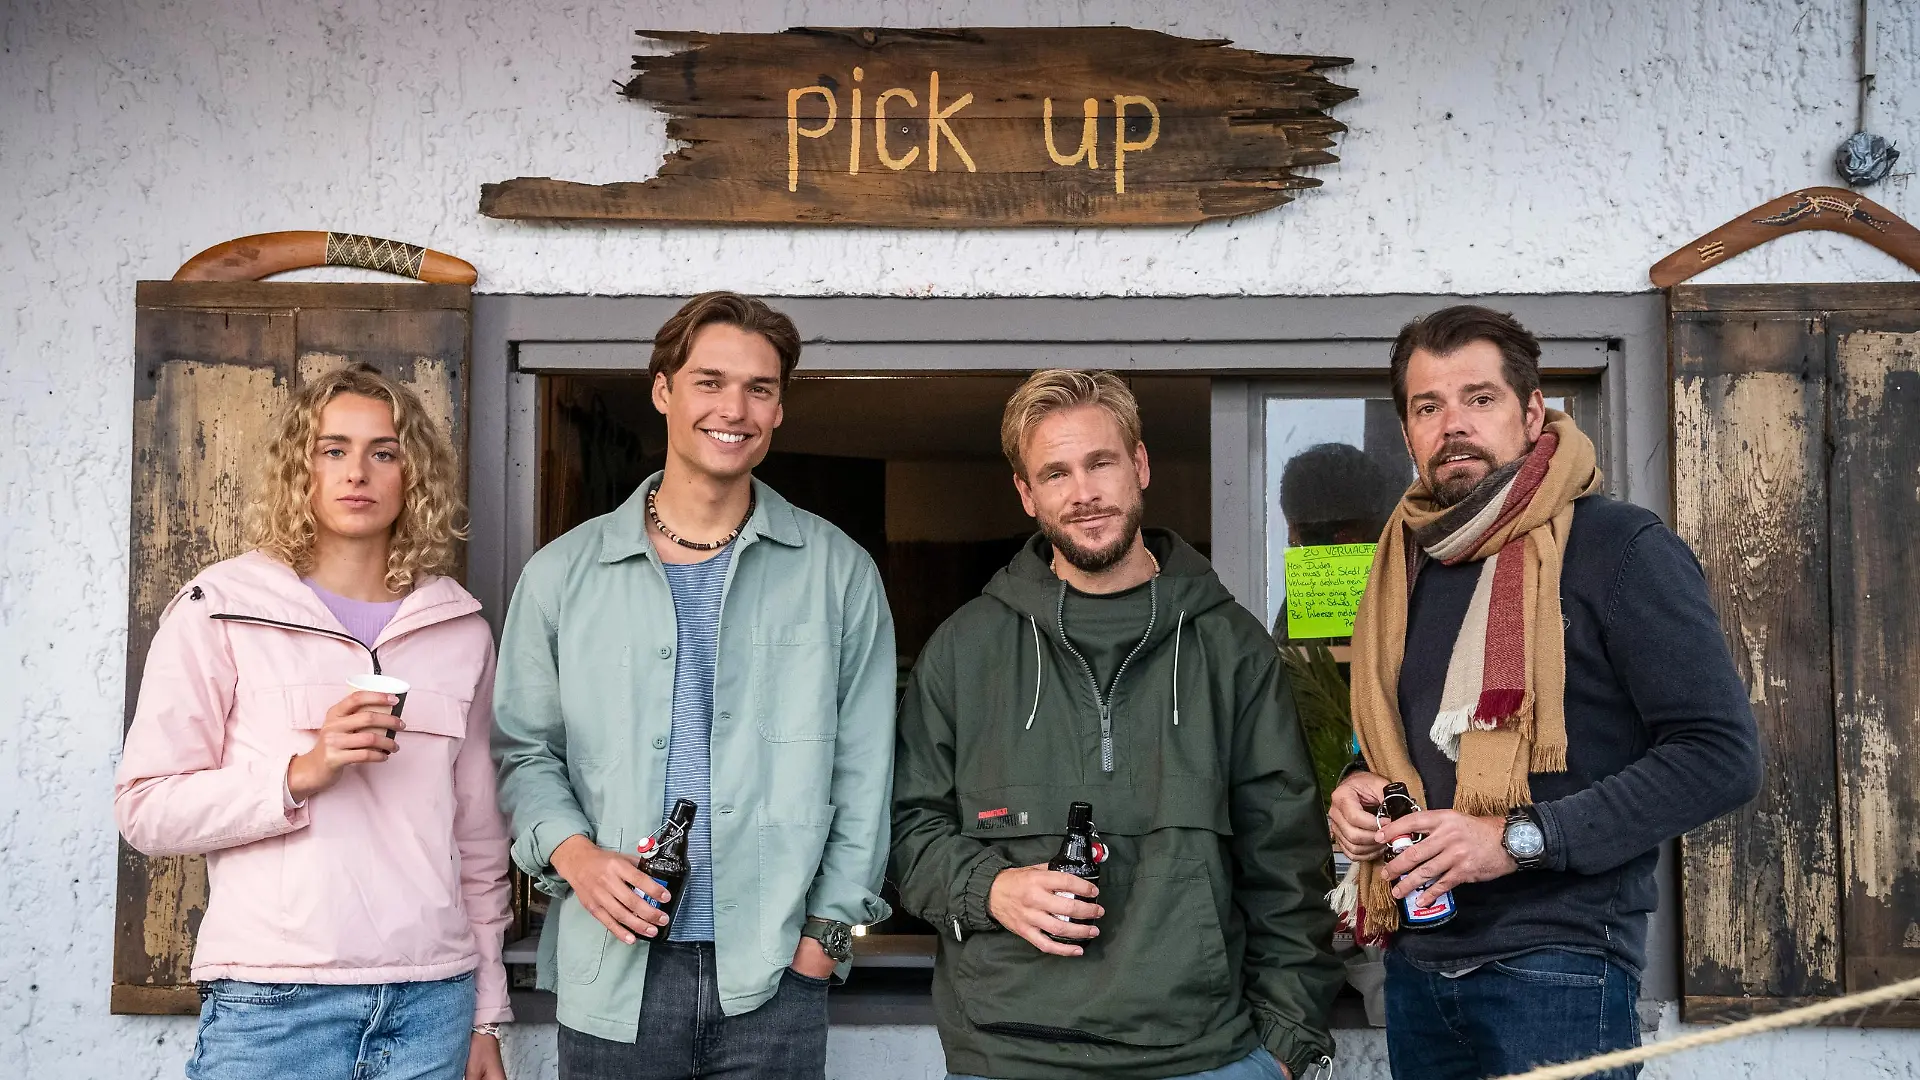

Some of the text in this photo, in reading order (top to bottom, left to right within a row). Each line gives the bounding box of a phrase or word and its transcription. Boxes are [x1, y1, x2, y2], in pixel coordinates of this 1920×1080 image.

[787, 66, 1160, 193] pick up
[1303, 545, 1377, 557] ZU VERKAUFE
[1338, 566, 1360, 576] Stadt
[1338, 609, 1357, 617] melde
[1344, 618, 1354, 627] Pe
